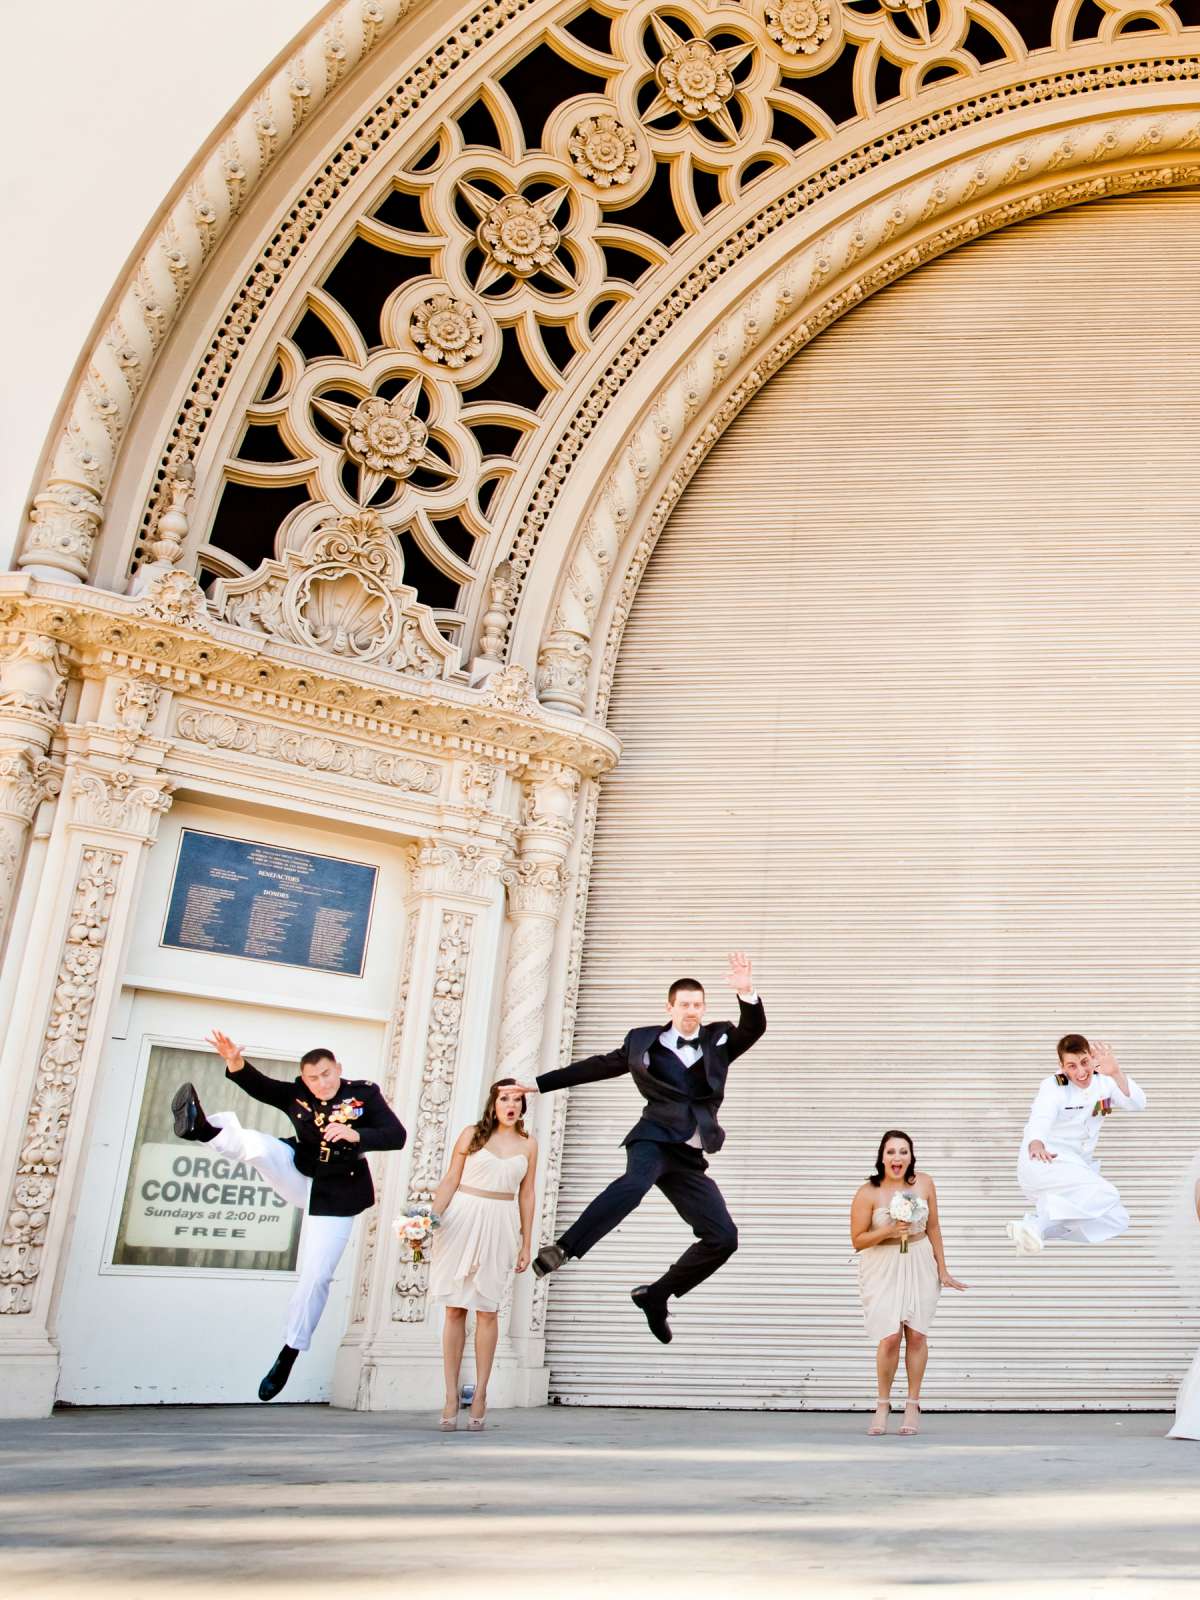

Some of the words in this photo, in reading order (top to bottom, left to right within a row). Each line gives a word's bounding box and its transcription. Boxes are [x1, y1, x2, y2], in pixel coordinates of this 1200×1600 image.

[258, 870, 300, 883] BENEFACTORS
[263, 889, 289, 899] DONORS
[141, 1179, 288, 1208] CONCERTS
[144, 1206, 205, 1221] Sundays
[208, 1209, 222, 1220] at
[224, 1211, 256, 1222] 2:00
[258, 1214, 280, 1224] pm
[174, 1226, 248, 1239] FREE
